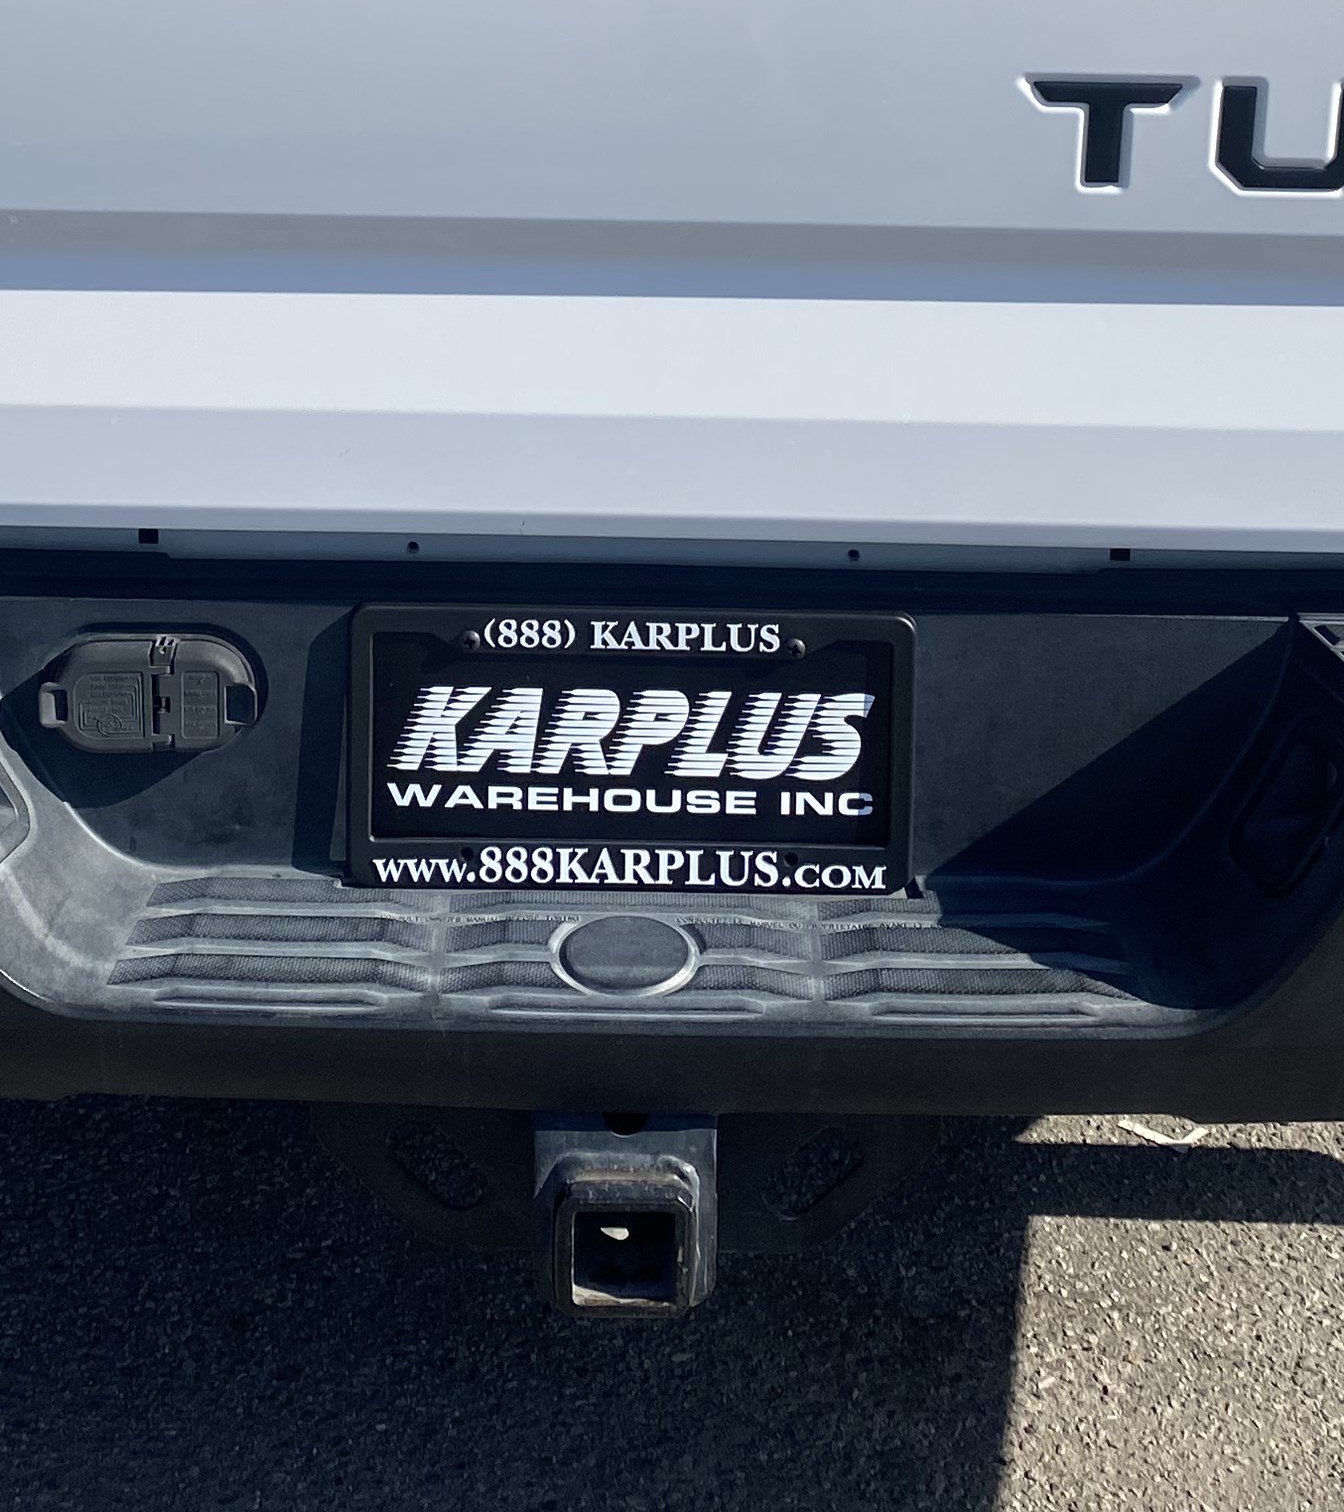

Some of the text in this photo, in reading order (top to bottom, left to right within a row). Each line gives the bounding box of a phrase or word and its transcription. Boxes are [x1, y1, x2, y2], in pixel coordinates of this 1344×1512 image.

[483, 617, 782, 653] (888) KARPLUS
[386, 685, 876, 781] KARPLUS
[387, 782, 874, 817] WAREHOUSE INC
